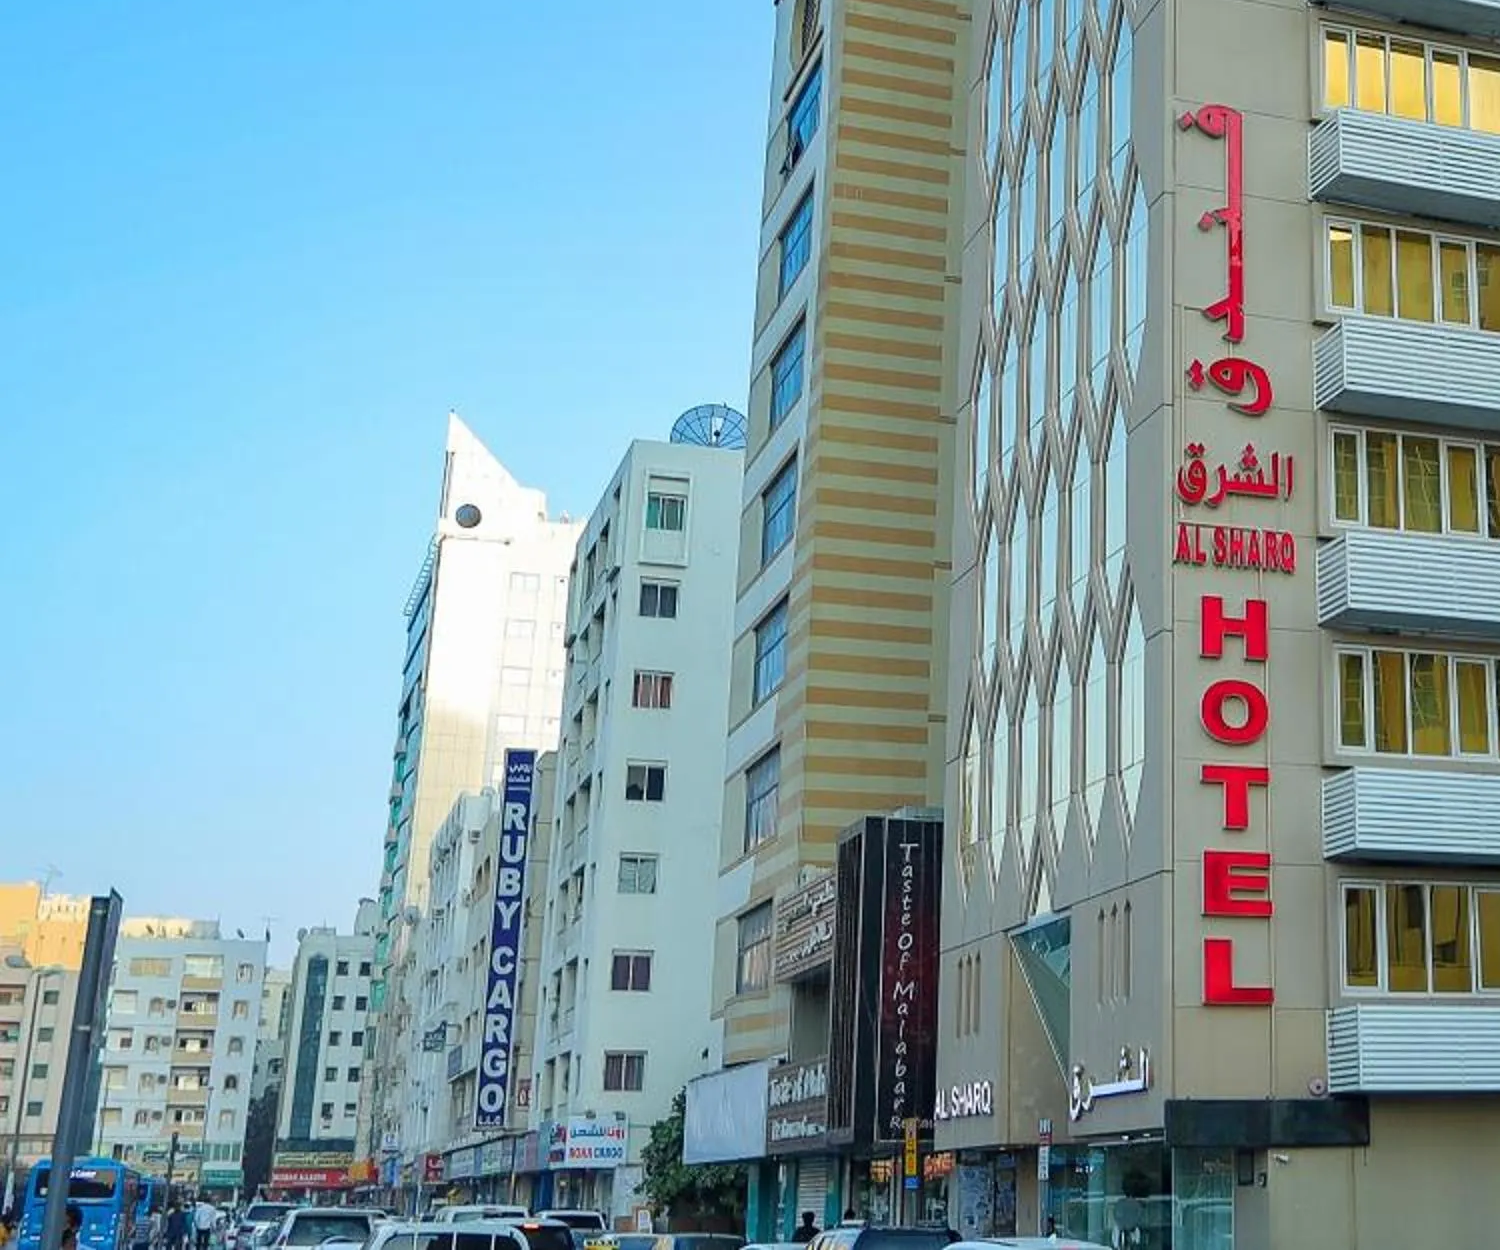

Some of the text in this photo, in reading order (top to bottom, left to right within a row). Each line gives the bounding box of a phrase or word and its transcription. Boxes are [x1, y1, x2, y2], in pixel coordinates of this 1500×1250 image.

[1177, 442, 1294, 508] الشرق
[1175, 522, 1296, 575] AL SHARQ
[1200, 594, 1274, 1006] HOTEL
[496, 802, 527, 930] RUBY
[899, 843, 919, 925] Taste
[897, 933, 913, 971] Of
[479, 946, 515, 1113] CARGO
[893, 981, 915, 1111] Malabar
[934, 1080, 992, 1121] AL SHARQ
